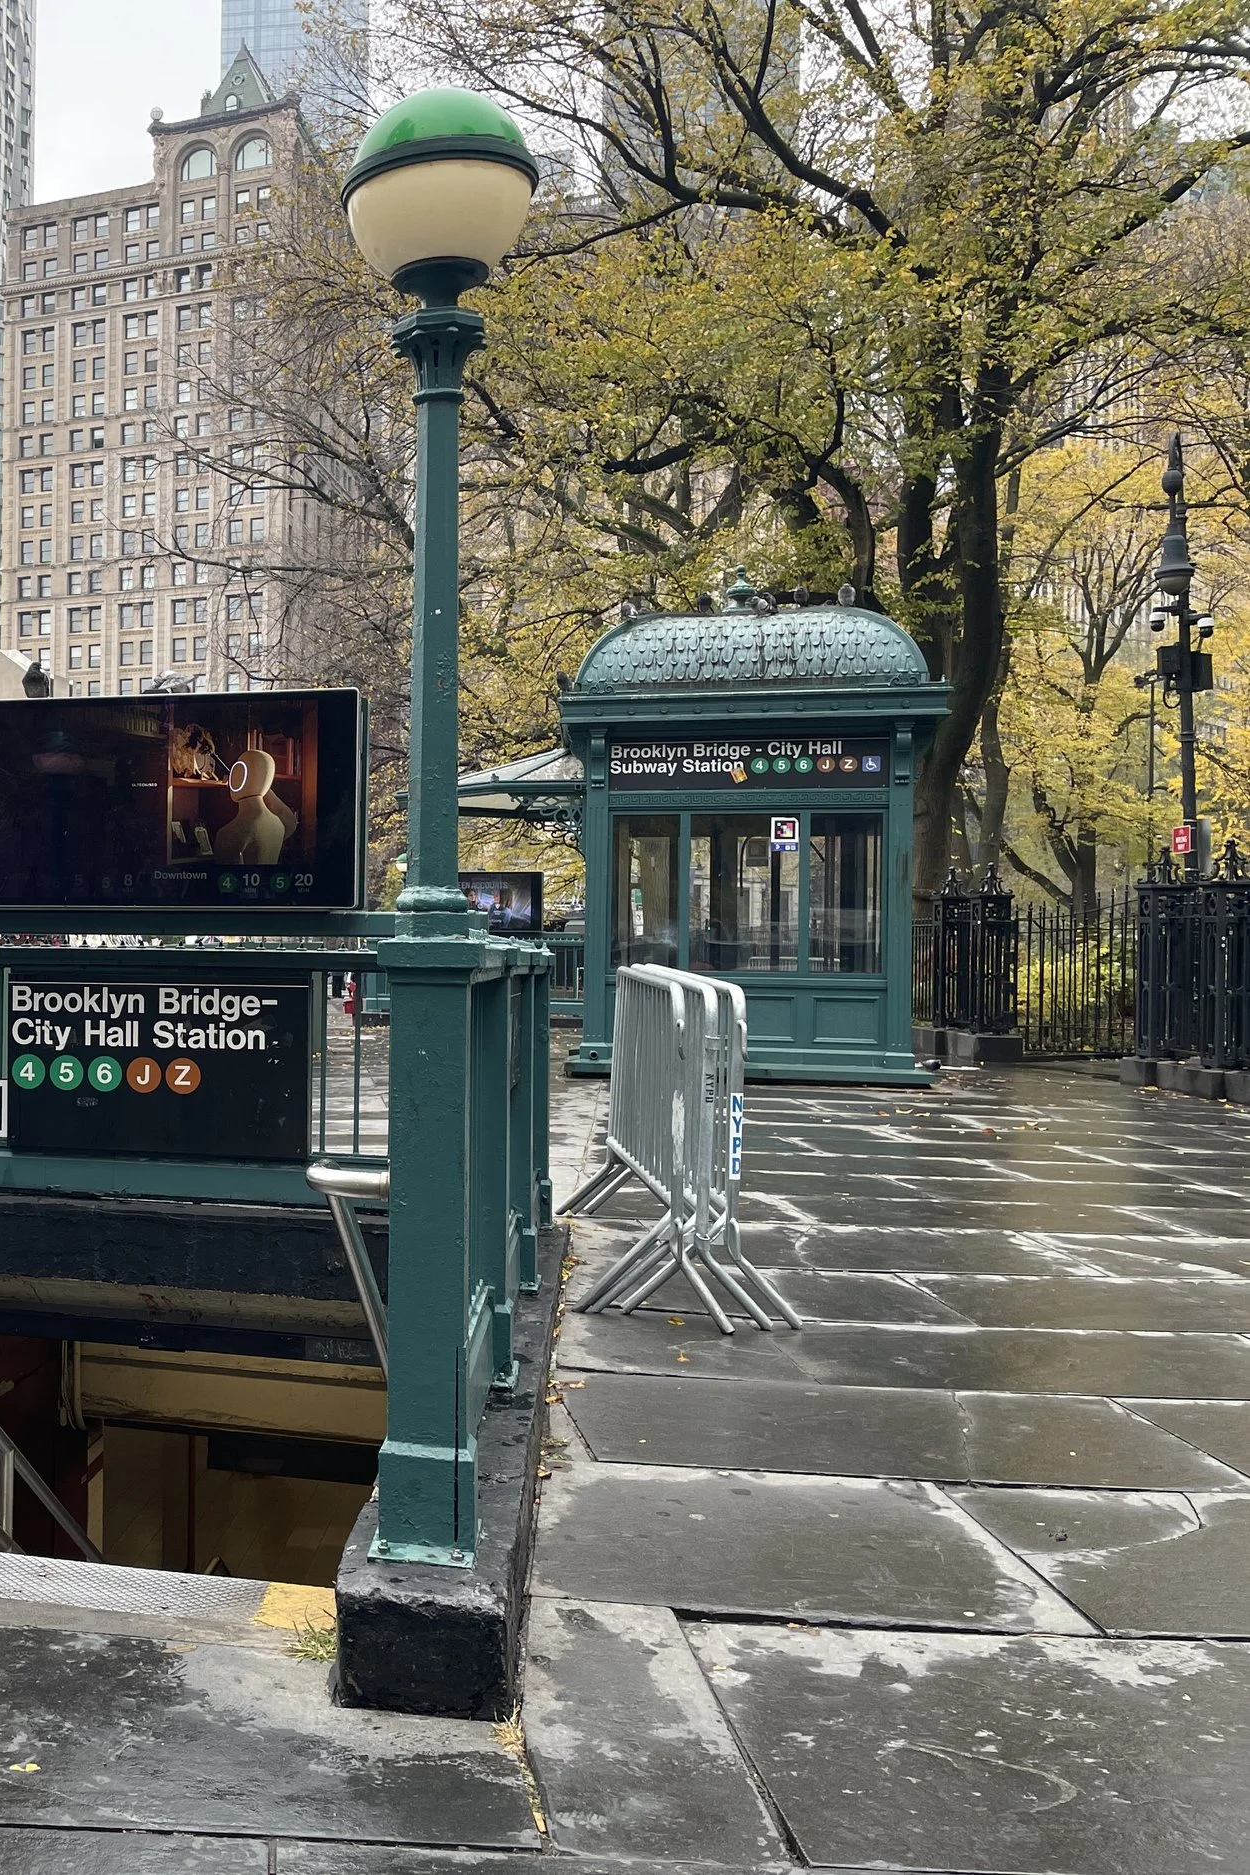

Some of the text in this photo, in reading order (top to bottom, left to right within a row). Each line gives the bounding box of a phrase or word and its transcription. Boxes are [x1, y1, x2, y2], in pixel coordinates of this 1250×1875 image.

[610, 744, 688, 761] Brooklyn
[693, 742, 751, 760] Bridge
[767, 741, 803, 759] City
[808, 740, 842, 755] Hall
[610, 758, 853, 777] Subway Station 4 5 6 J Z
[153, 870, 314, 889] Downtown 4 10 5 20
[470, 881, 509, 890] ACCOUNTS
[11, 985, 278, 1022] Brooklyn Bridge-
[11, 1017, 266, 1051] City Hall Station
[19, 1061, 191, 1086] 4 5 6 J Z
[705, 1073, 715, 1103] NYPD
[731, 1095, 743, 1175] NYPD
